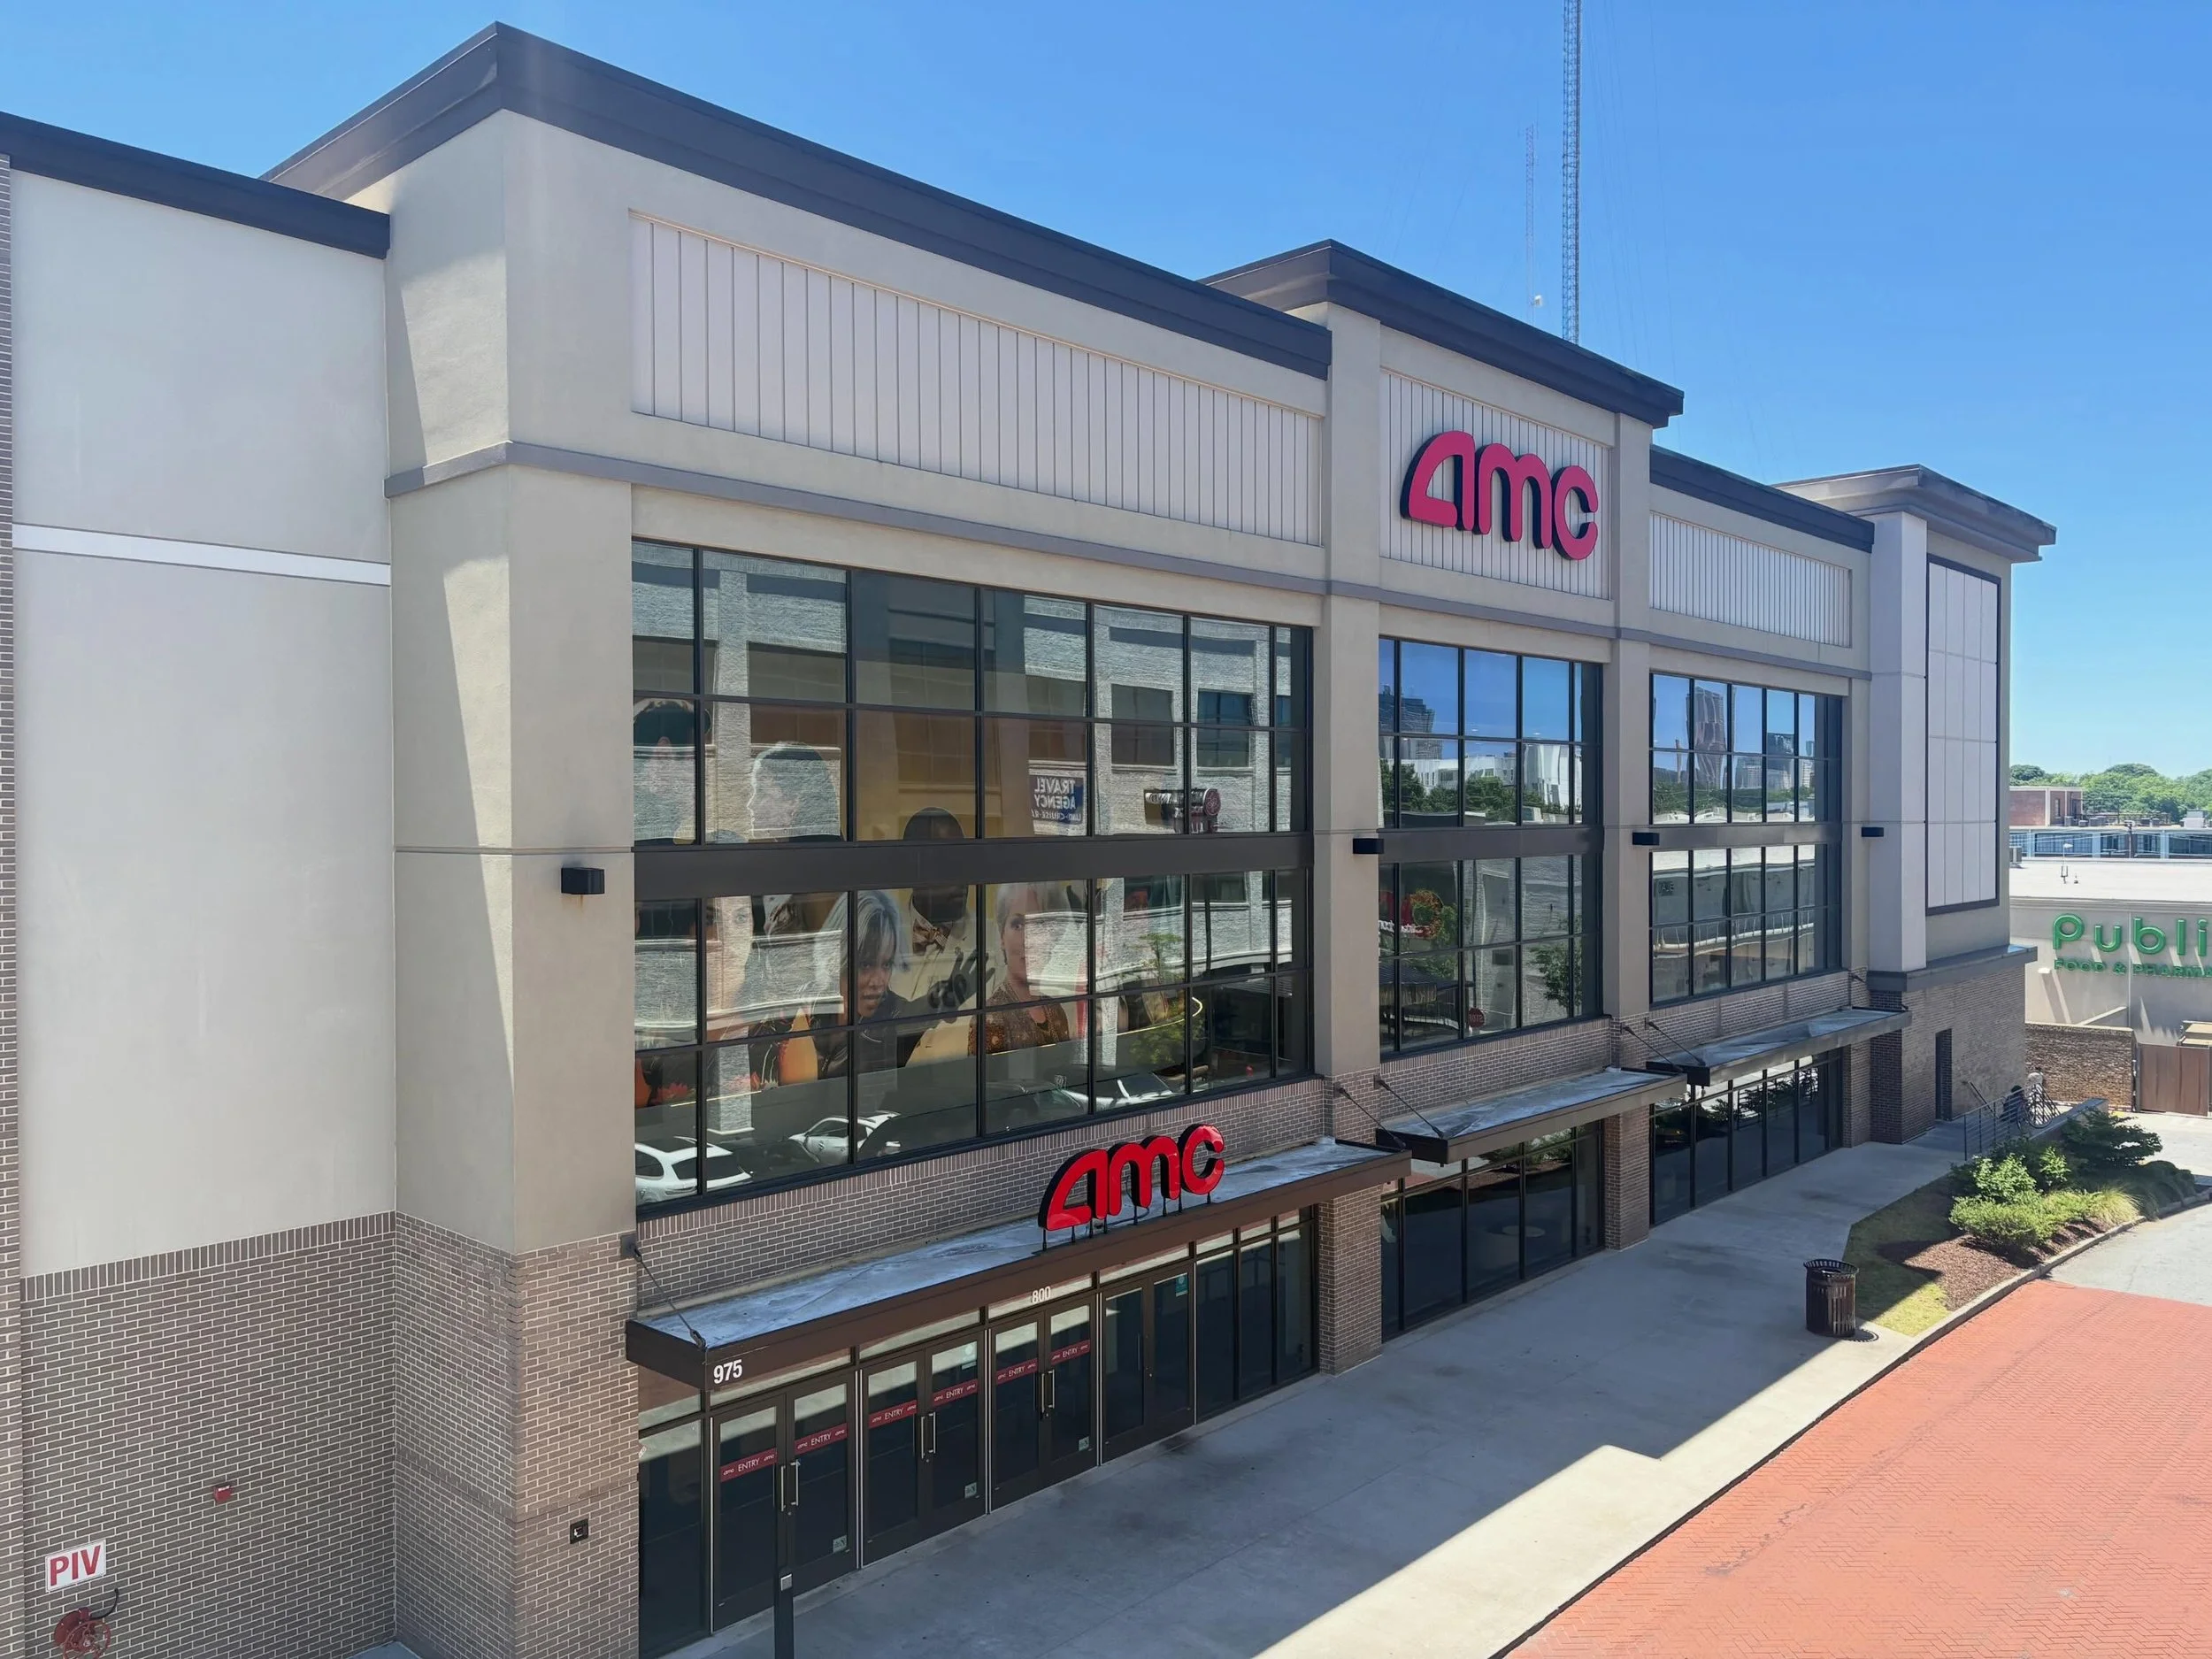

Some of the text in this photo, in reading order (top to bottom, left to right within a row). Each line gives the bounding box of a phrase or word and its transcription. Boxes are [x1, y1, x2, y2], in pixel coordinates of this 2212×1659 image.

[2054, 957, 2106, 972] FOOD
[1032, 1286, 1051, 1303] 800
[713, 1359, 742, 1384] 975
[946, 1386, 964, 1399] ENTRY
[884, 1408, 903, 1420] ENTRY
[810, 1432, 831, 1446] ENTRY
[738, 1458, 759, 1472] ENTRY
[50, 1545, 101, 1586] PIV
